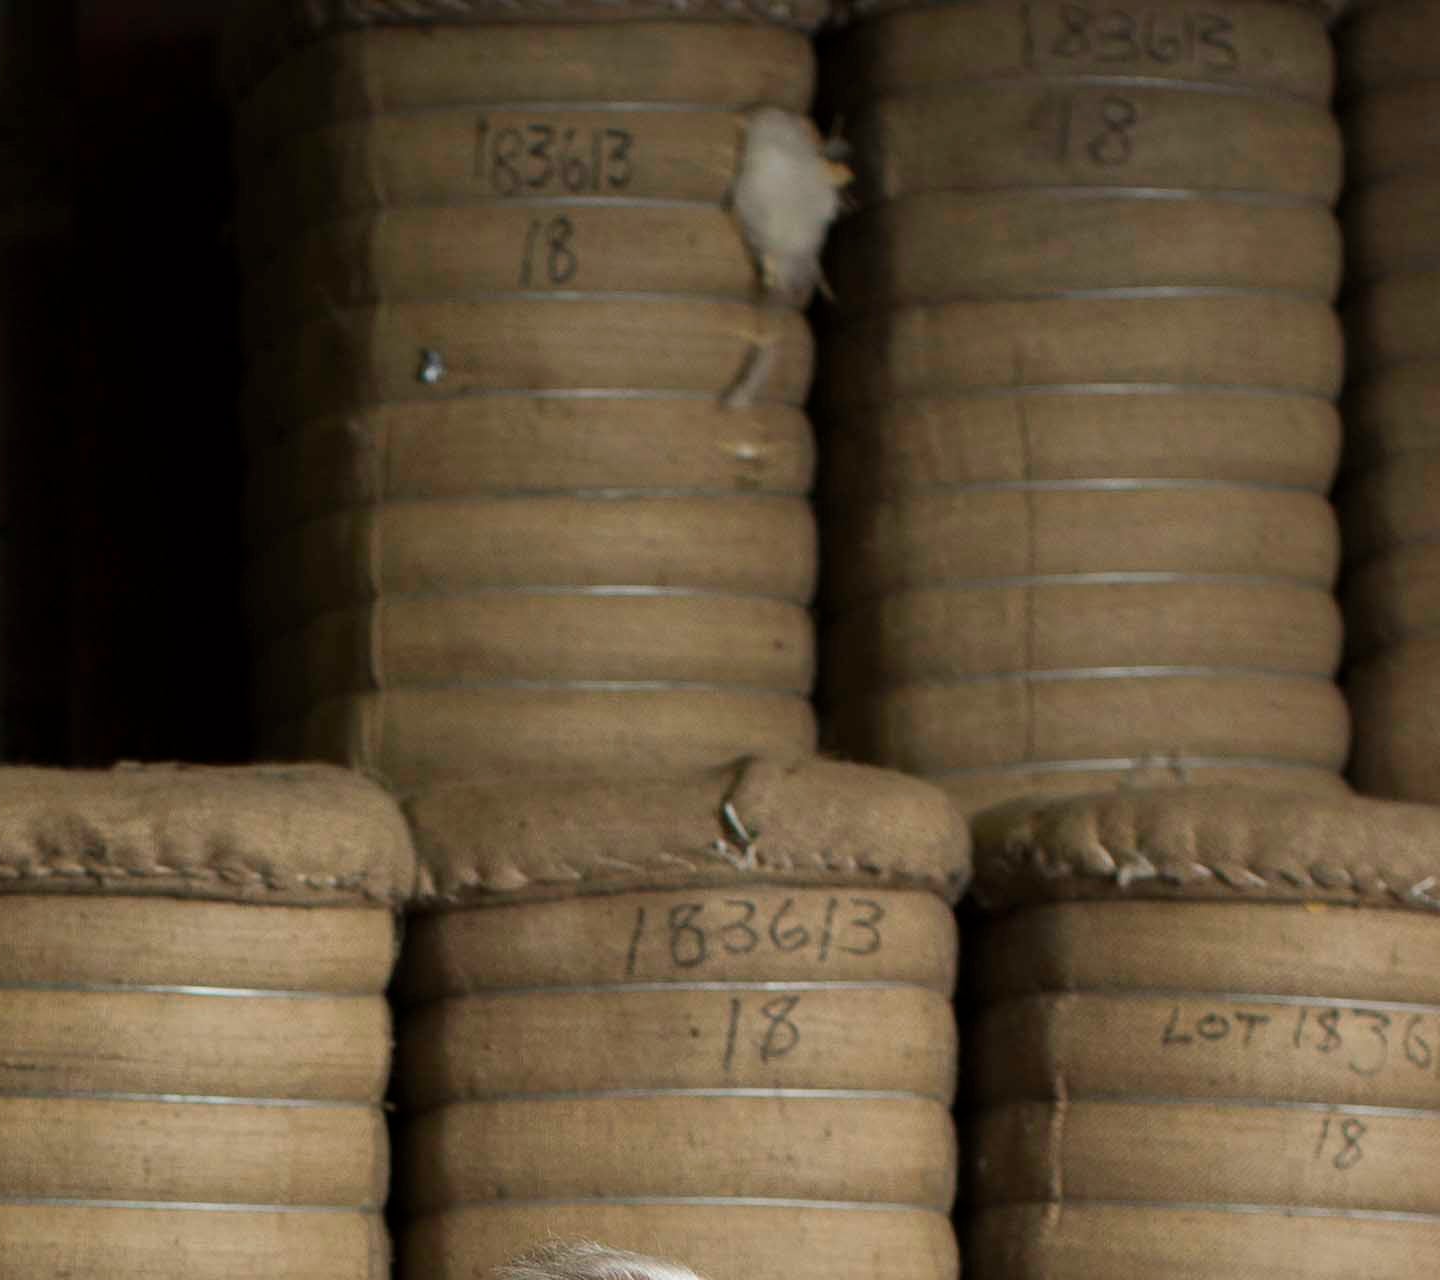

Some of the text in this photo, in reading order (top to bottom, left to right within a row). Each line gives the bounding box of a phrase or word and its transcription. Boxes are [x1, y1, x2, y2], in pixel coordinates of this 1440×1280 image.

[1023, 5, 1238, 70] 183613
[470, 116, 634, 196] 183613
[522, 218, 580, 286] 18
[625, 899, 886, 976] 183613
[722, 996, 801, 1071] 18
[1160, 1007, 1270, 1046] LOT
[1315, 1118, 1368, 1170] 18
